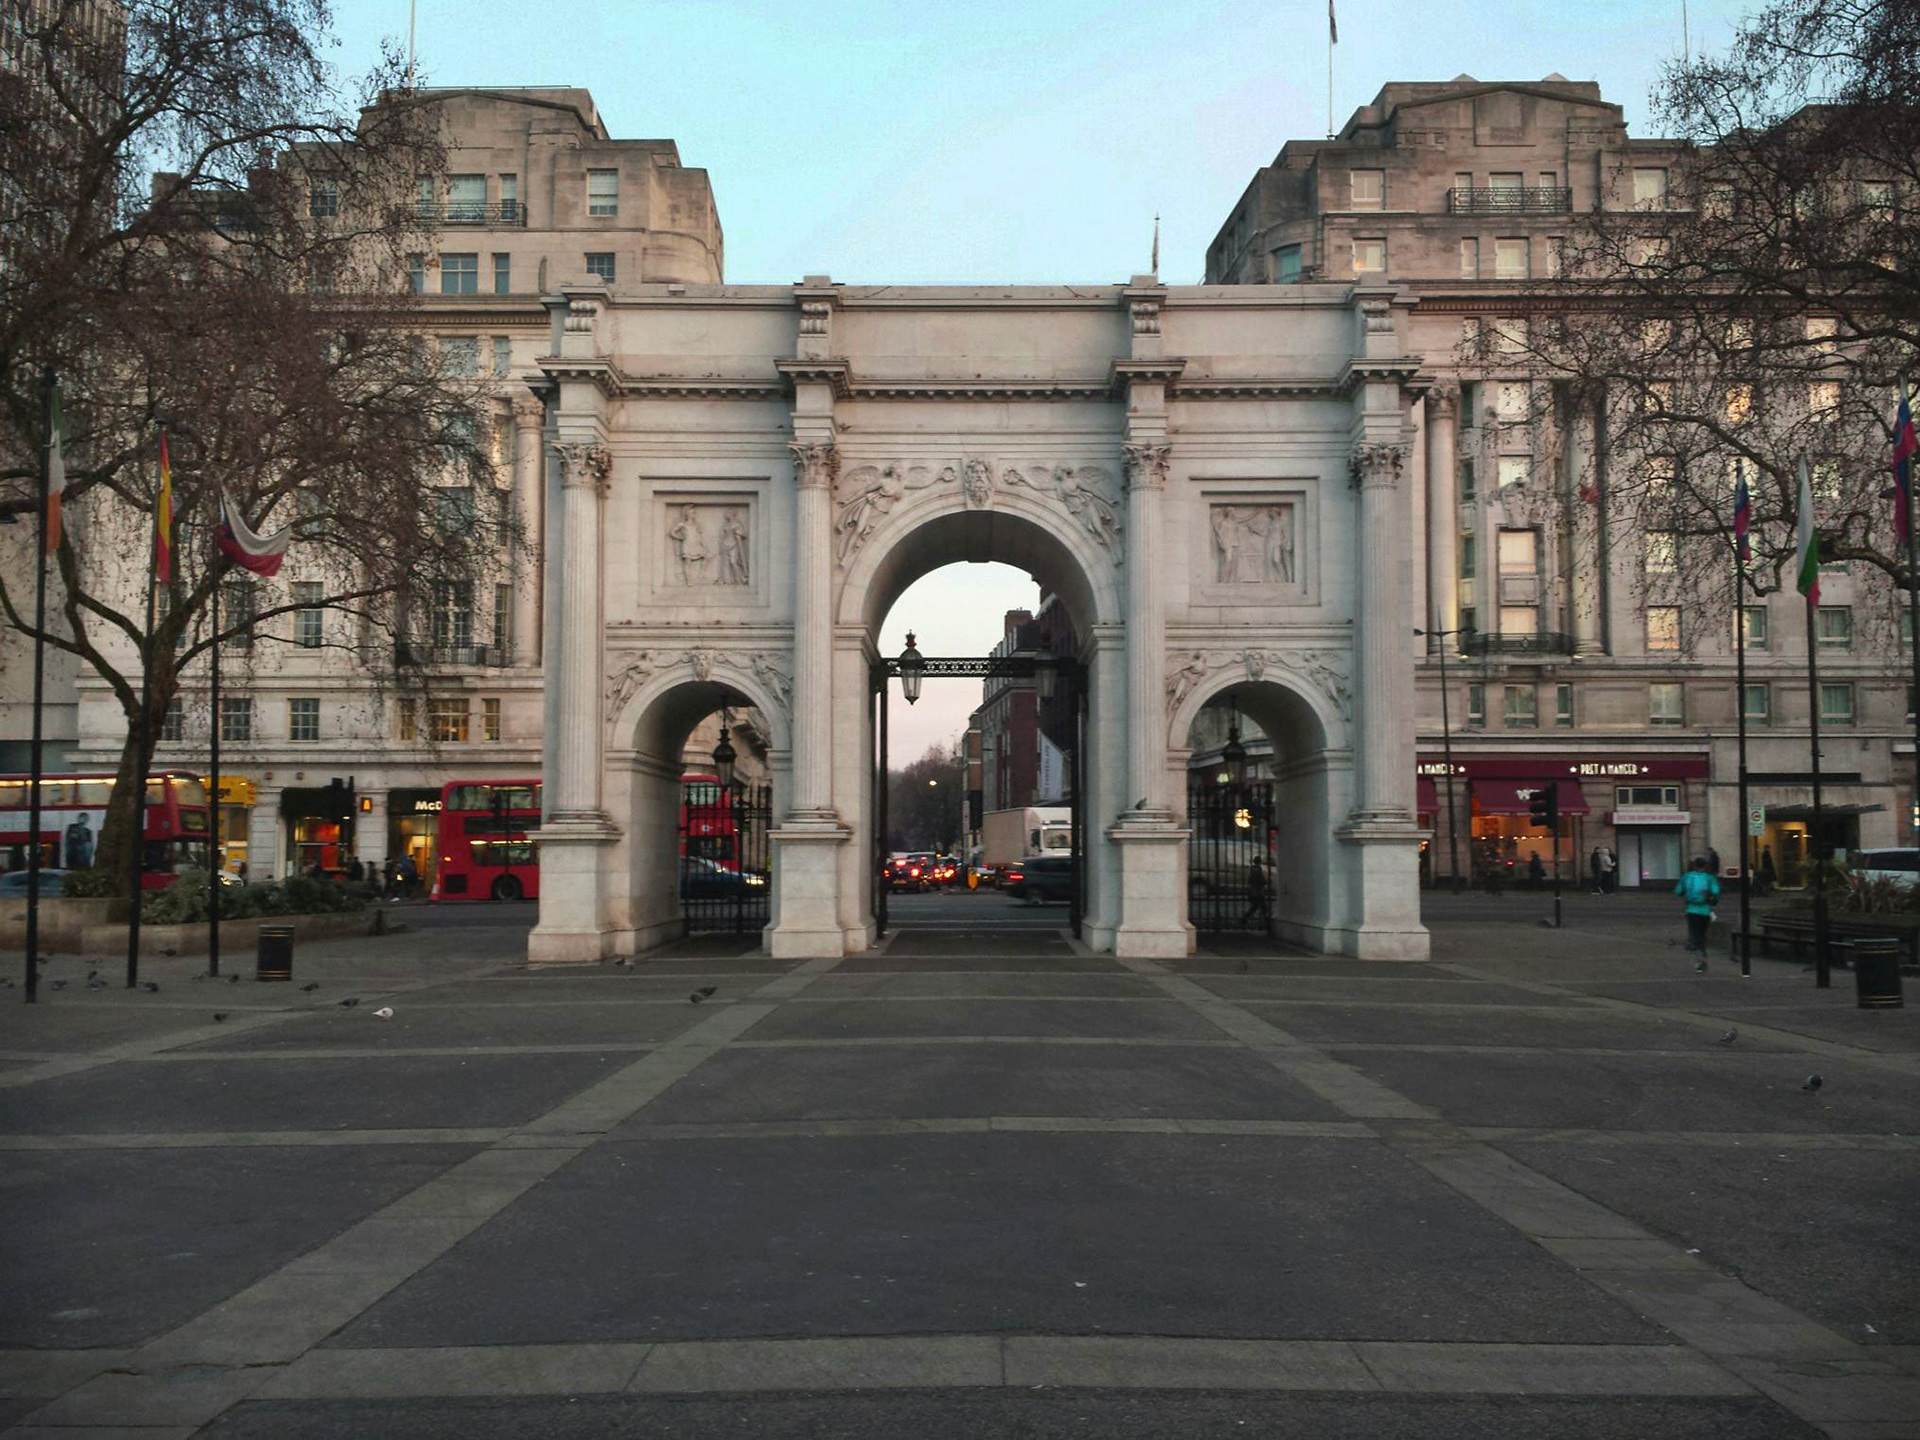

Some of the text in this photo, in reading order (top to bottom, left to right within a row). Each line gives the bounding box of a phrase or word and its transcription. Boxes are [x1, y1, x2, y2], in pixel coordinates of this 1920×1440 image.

[1424, 763, 1455, 774] MANGR
[1580, 763, 1638, 775] PRET A MANGER
[415, 801, 443, 810] McD
